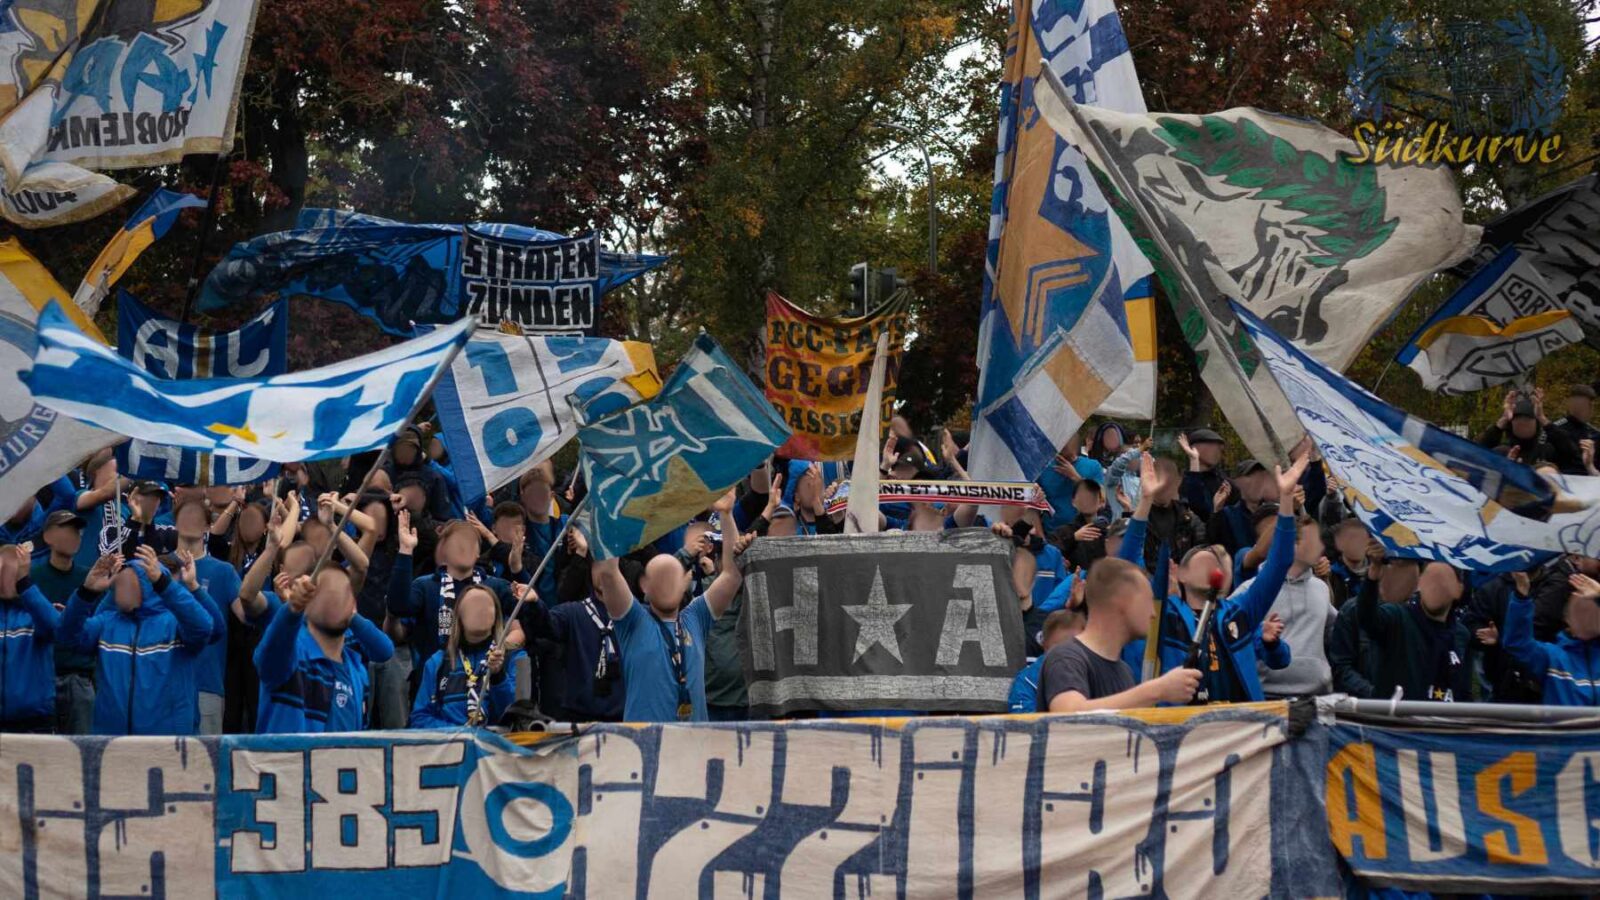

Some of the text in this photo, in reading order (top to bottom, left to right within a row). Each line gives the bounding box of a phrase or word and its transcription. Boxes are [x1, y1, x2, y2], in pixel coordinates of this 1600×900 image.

[462, 235, 599, 282] STRAFEN
[466, 278, 593, 329] ZÜNDEN
[1508, 281, 1554, 316] CAR
[911, 484, 931, 496] ET
[937, 485, 1025, 501] LAUSANNE
[230, 741, 465, 874] 385
